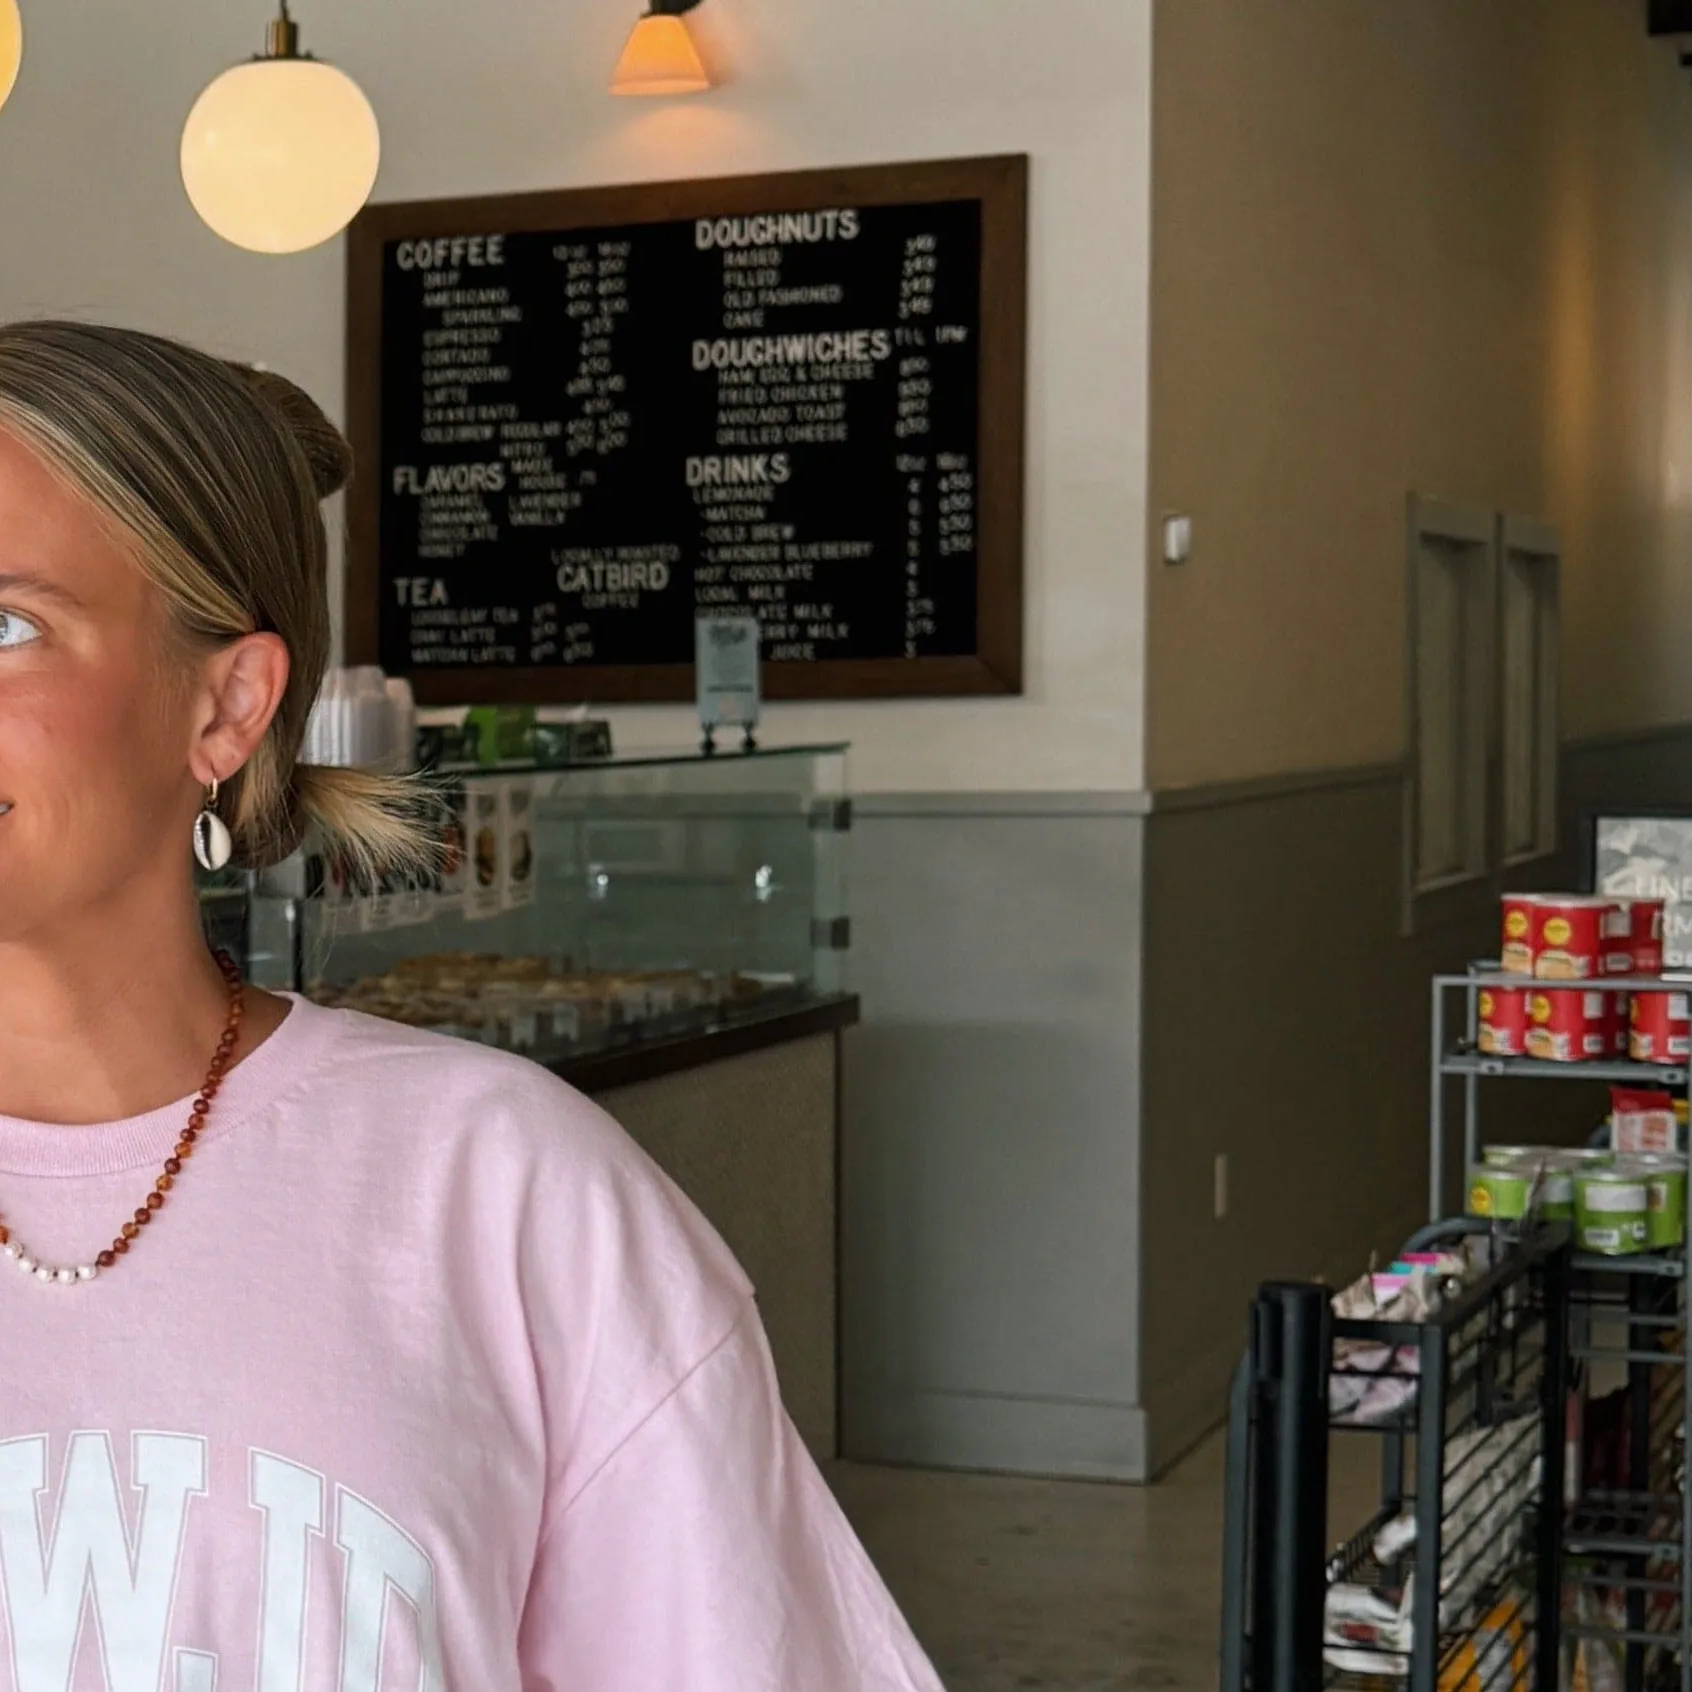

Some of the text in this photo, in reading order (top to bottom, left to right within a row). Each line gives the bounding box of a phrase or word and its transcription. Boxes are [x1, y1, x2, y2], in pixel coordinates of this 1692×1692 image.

[696, 209, 860, 250] DOUGHNUTS
[397, 237, 505, 269] COFFEE
[692, 328, 892, 369] DOUGHWICHES
[394, 463, 505, 494] FLAVORS
[686, 453, 791, 486] DRINKS
[394, 578, 447, 606] TEA
[557, 564, 669, 592] CATBIRD
